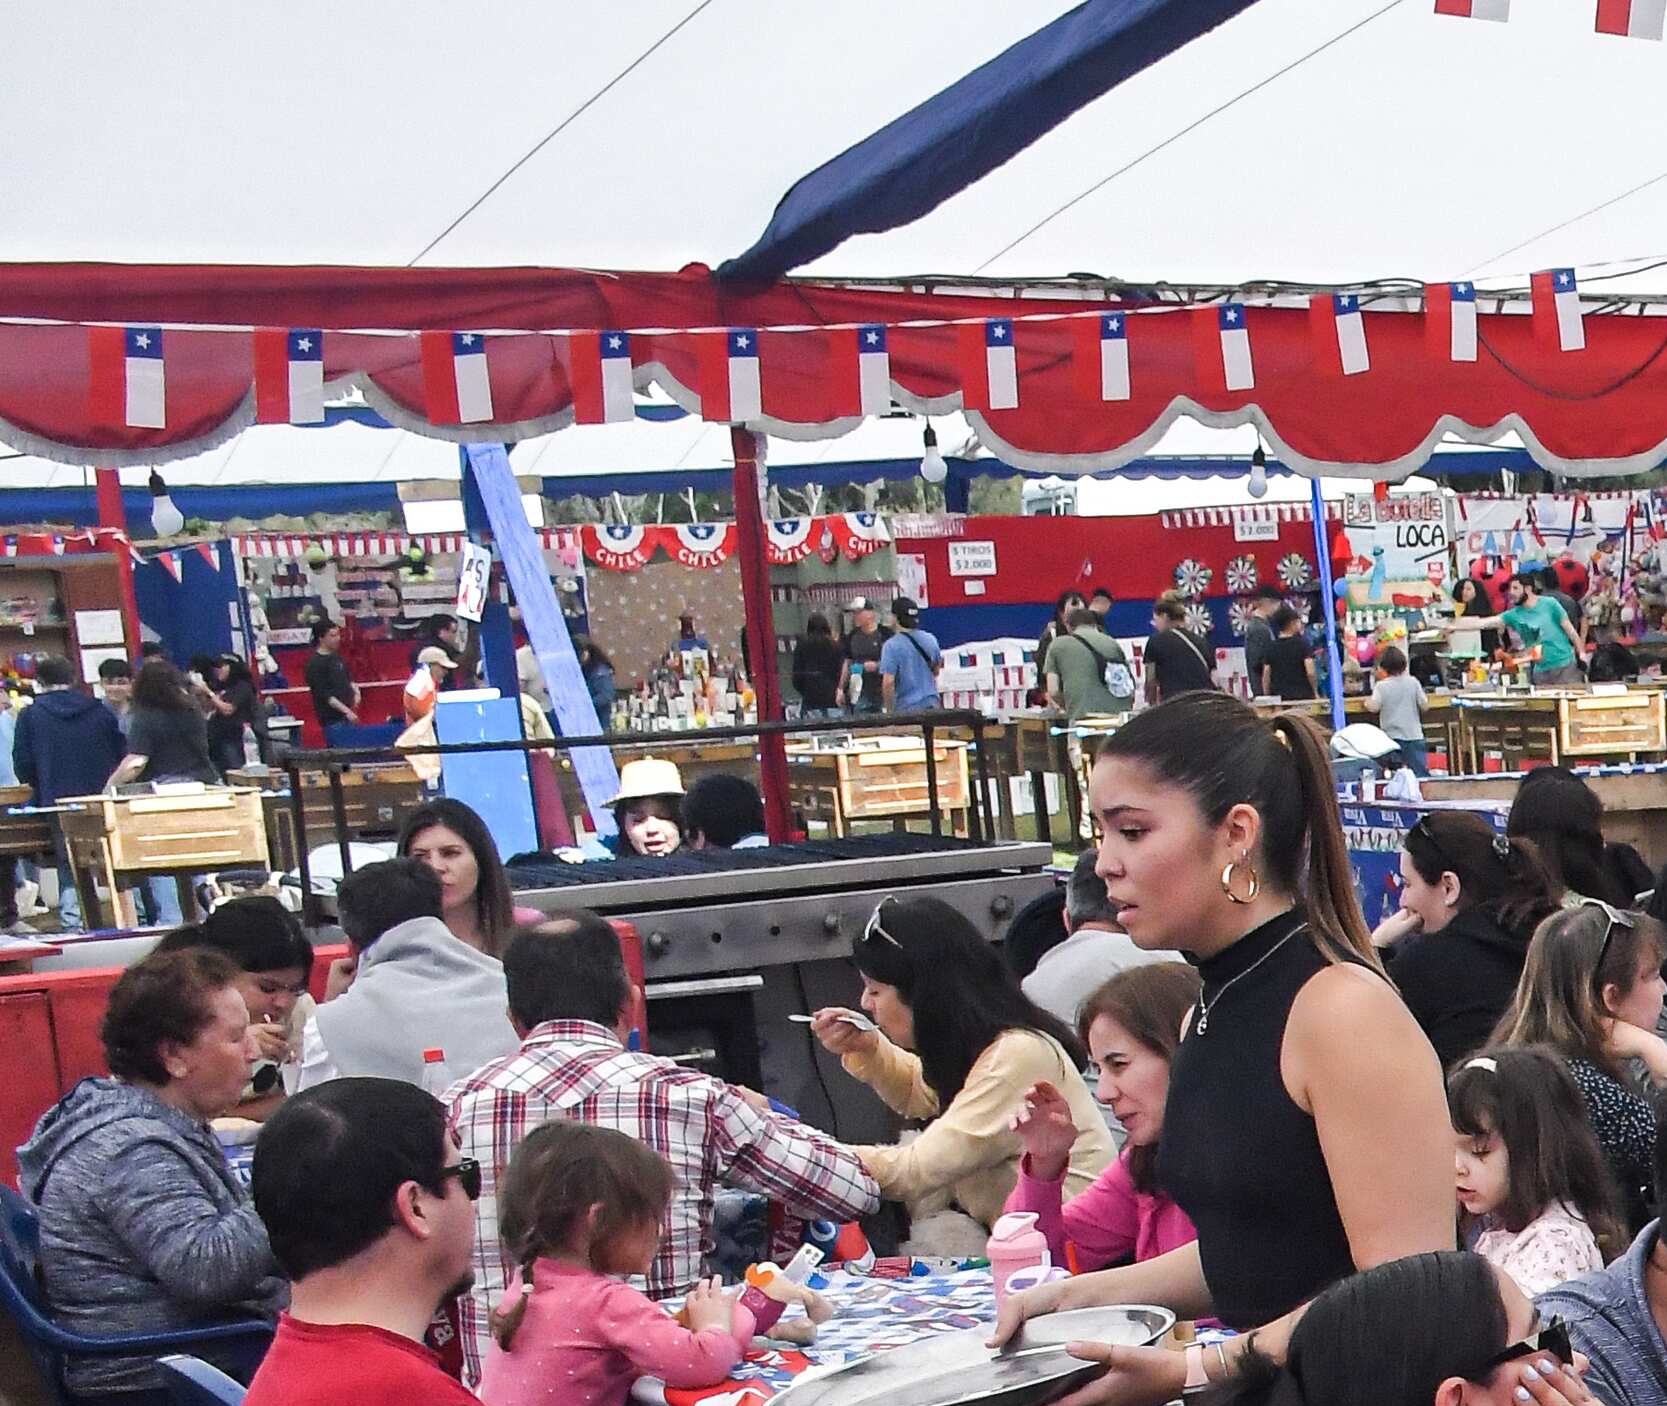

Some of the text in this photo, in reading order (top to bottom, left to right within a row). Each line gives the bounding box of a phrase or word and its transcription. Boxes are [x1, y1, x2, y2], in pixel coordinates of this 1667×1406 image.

[1396, 524, 1446, 548] LOCA
[596, 549, 648, 569] CHILE
[679, 548, 728, 568] CHILE
